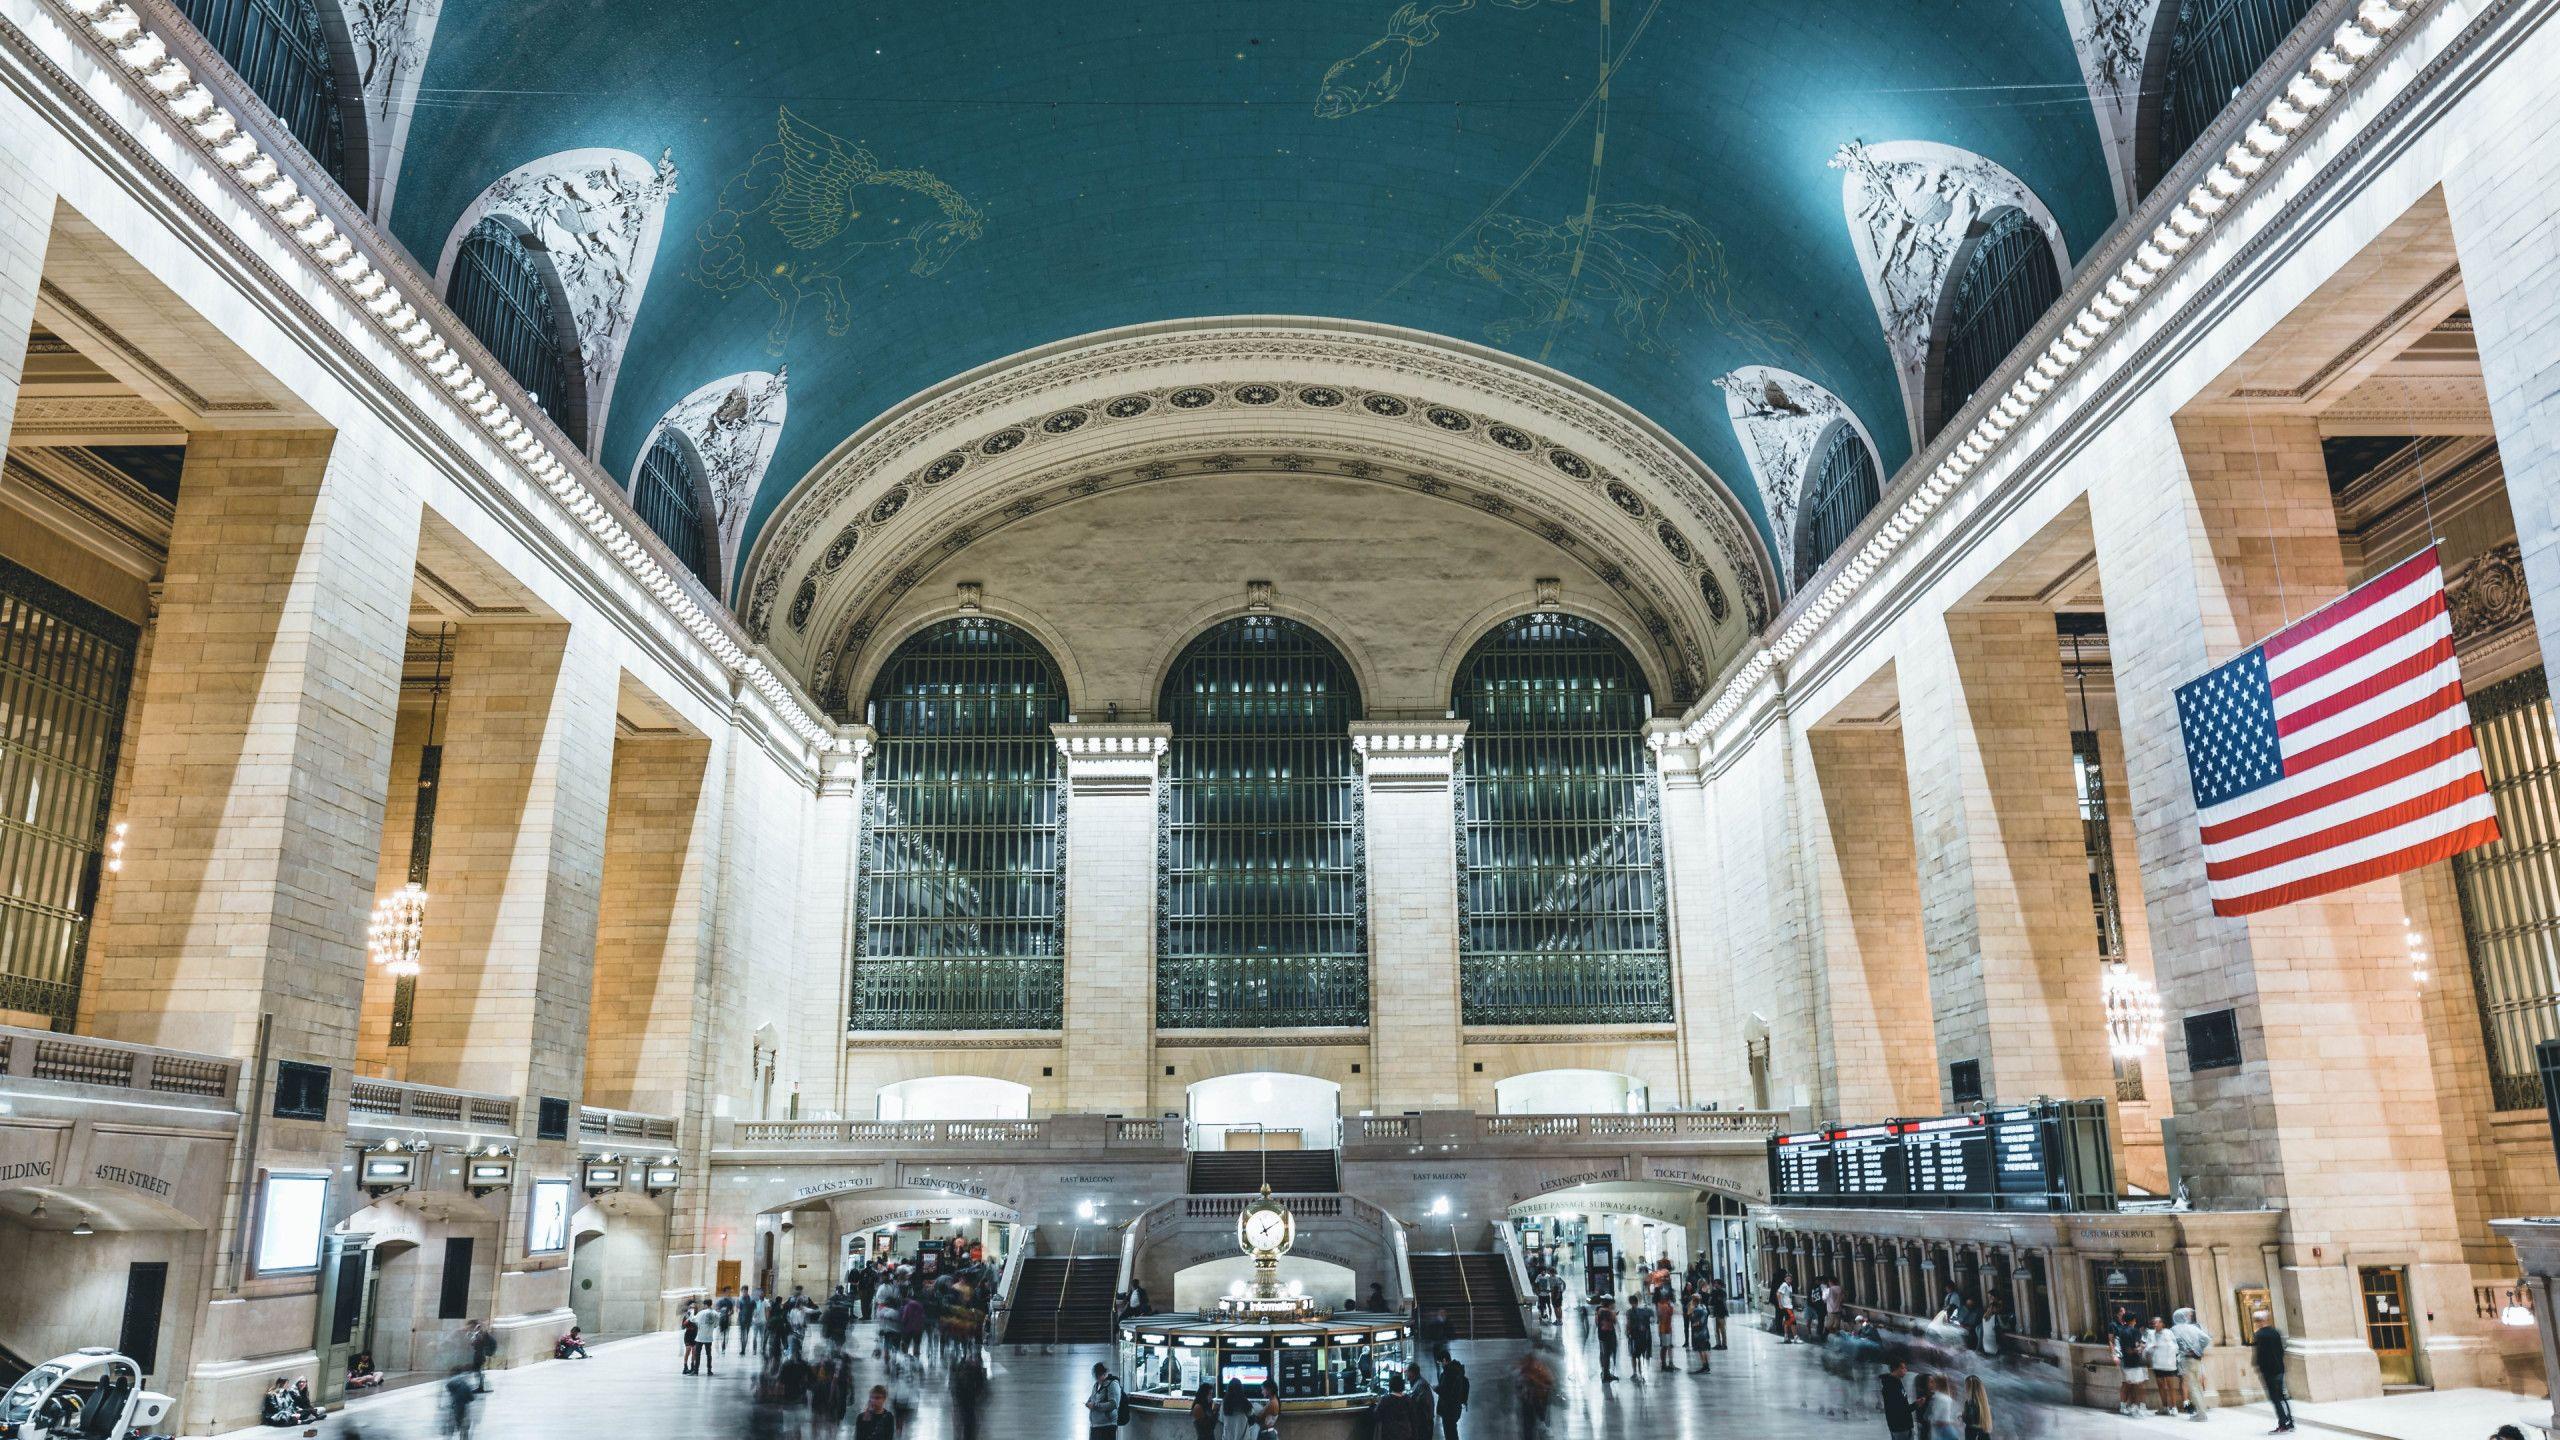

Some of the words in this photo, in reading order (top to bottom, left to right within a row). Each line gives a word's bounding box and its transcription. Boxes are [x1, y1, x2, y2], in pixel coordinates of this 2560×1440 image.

[95, 1164, 127, 1183] 45TH
[127, 1170, 172, 1196] STREET
[907, 1176, 967, 1192] LEXINGTON
[968, 1185, 988, 1196] AVE
[1413, 1173, 1430, 1181] EAST
[1540, 1172, 1598, 1191] LEXINGTON
[1600, 1169, 1619, 1179] AVE
[1653, 1169, 1687, 1180] TICKET
[1691, 1172, 1742, 1190] MACHINES
[798, 1182, 836, 1196] TRACKS
[1519, 1204, 1548, 1214] STREET
[1550, 1201, 1585, 1210] PASSAGE
[1589, 1200, 1624, 1210] SUBWAY
[861, 1214, 883, 1226] 42ND
[884, 1208, 913, 1221] STREET
[916, 1208, 951, 1217] PASSAGE
[2080, 1229, 2121, 1239] CUSTOMER
[2121, 1230, 2156, 1239] SERVICE
